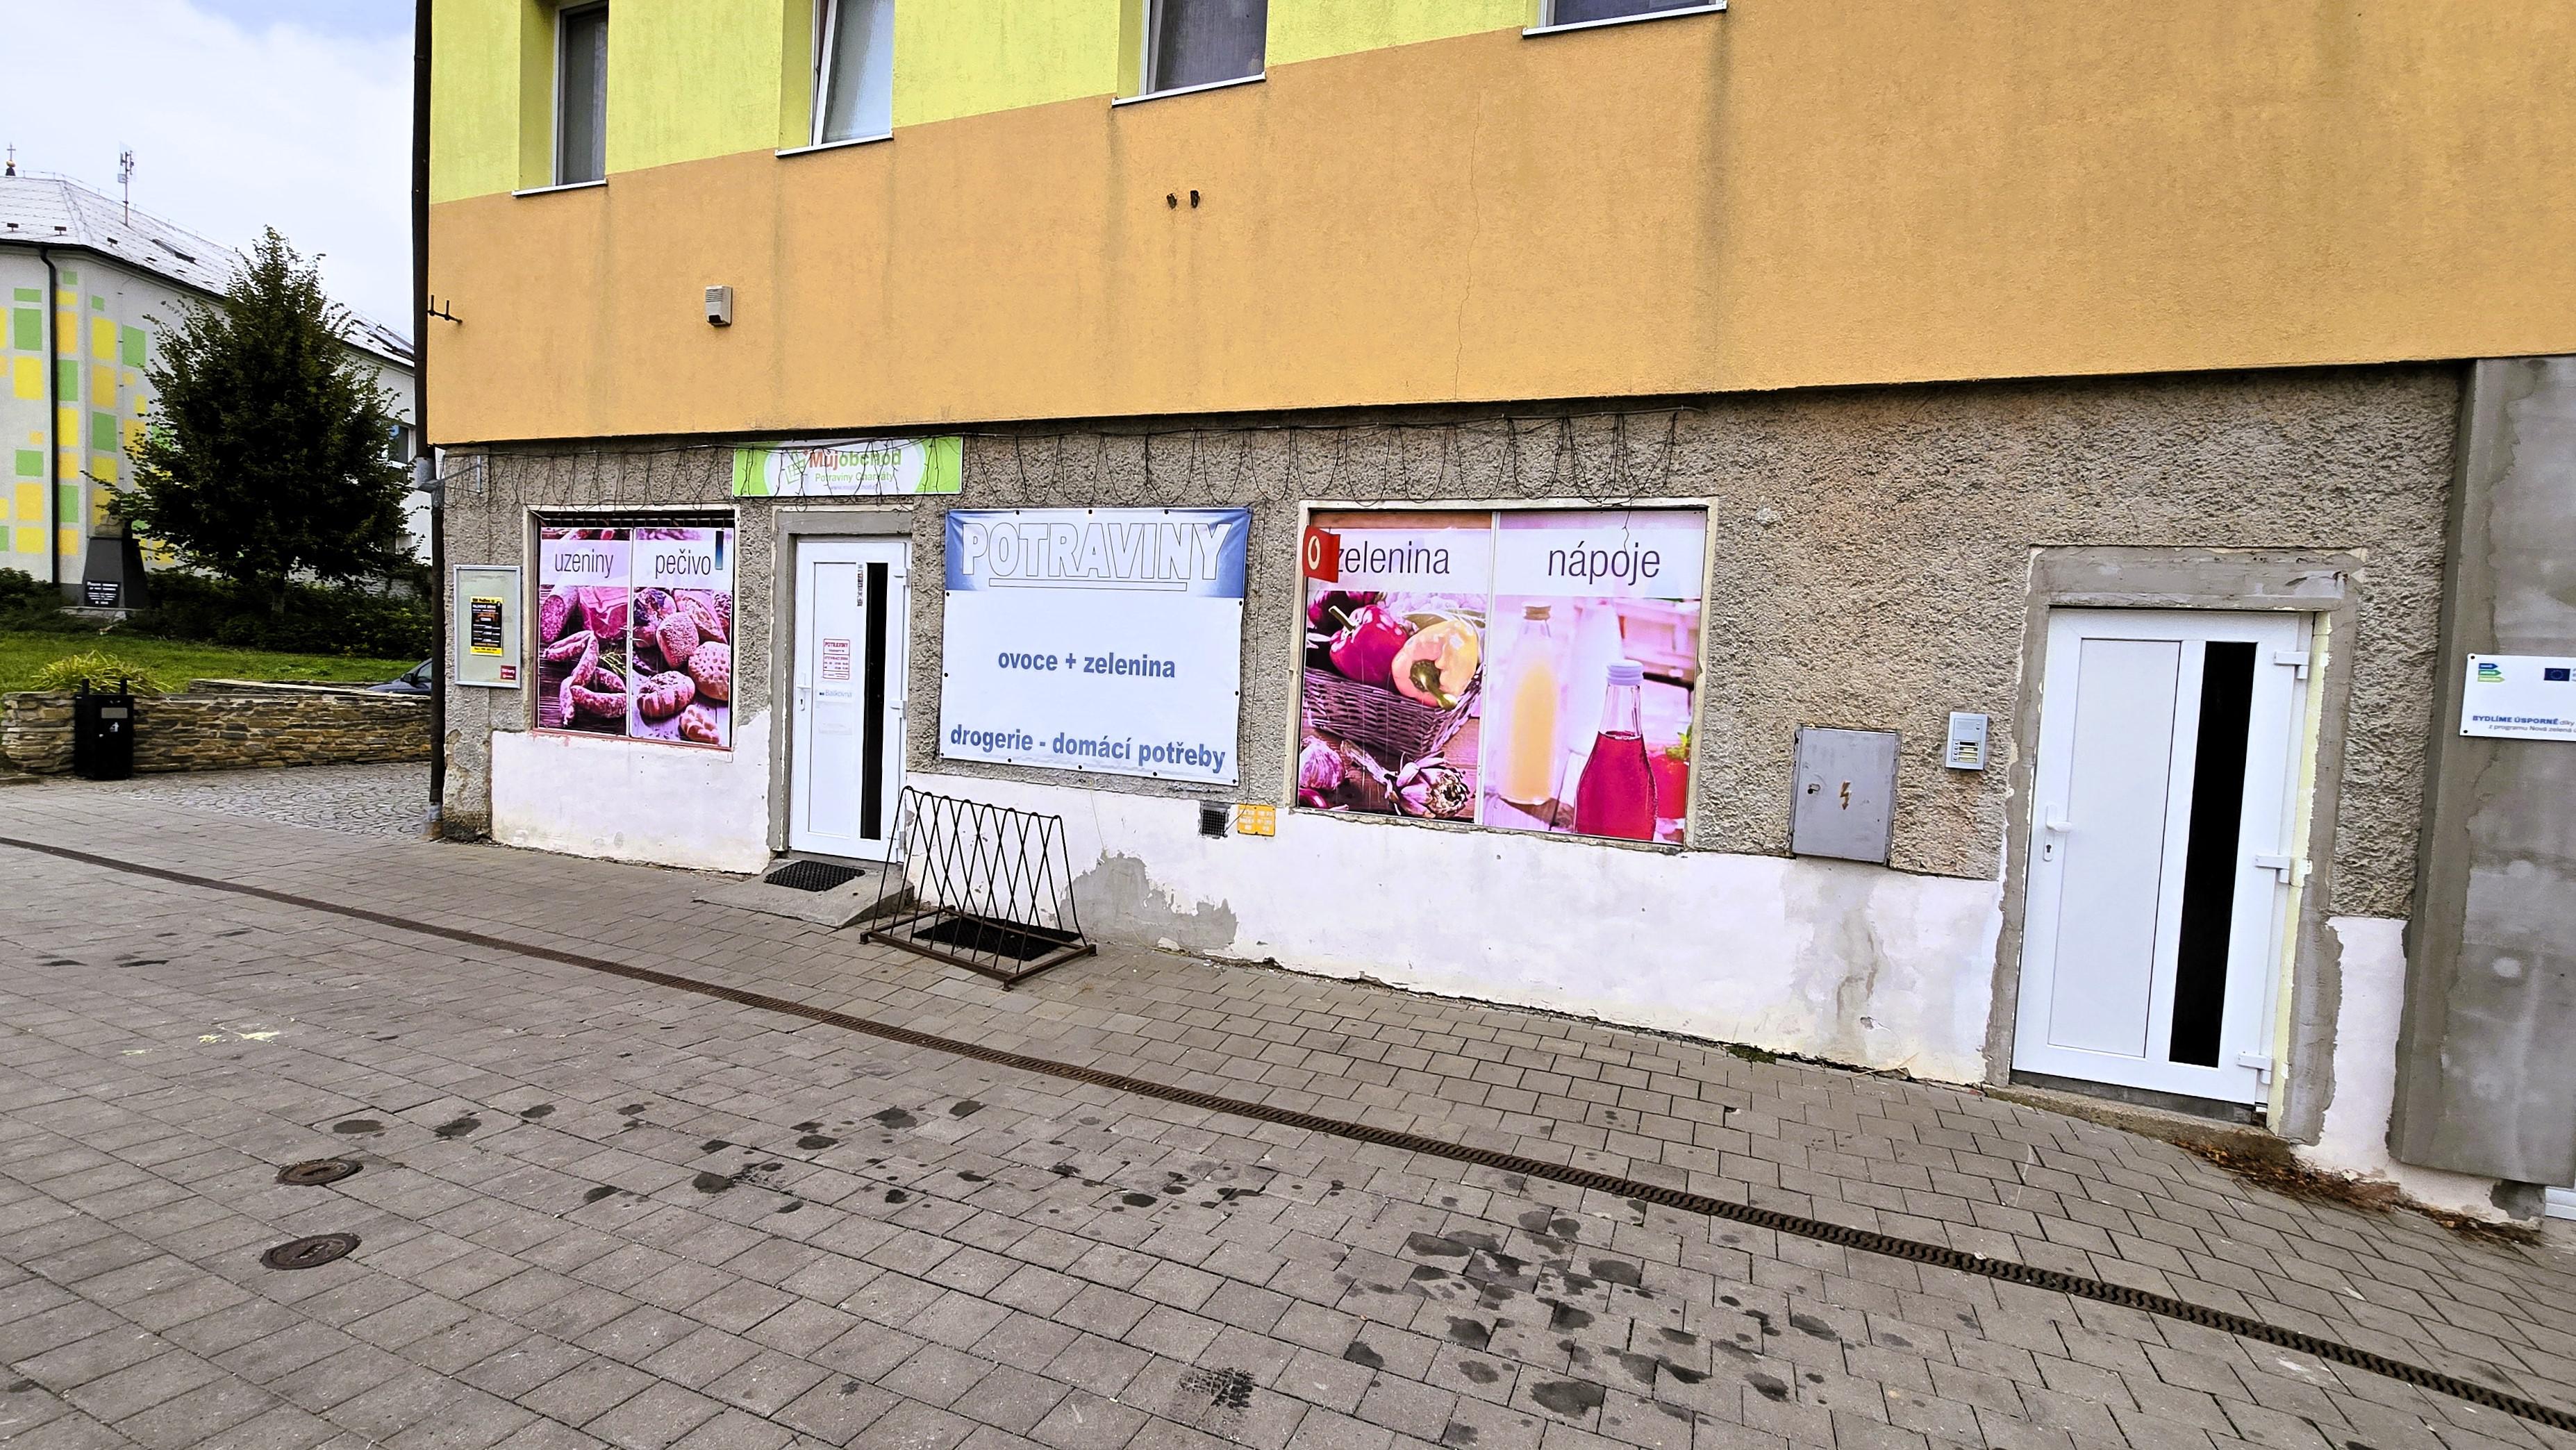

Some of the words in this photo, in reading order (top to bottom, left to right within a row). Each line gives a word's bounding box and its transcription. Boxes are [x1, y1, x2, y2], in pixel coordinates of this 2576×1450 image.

[815, 473, 853, 483] Potraviny
[554, 549, 613, 578] uzeniny
[655, 549, 711, 579] pečivo
[962, 522, 1233, 581] POTRAVINY
[1548, 540, 1661, 586] nápoje
[998, 652, 1058, 672] ovoce
[1065, 653, 1077, 670] +
[1083, 651, 1176, 678] zelenina
[950, 724, 1033, 753] drogerie
[1052, 733, 1131, 760] domácí
[1138, 741, 1226, 774] potřeby
